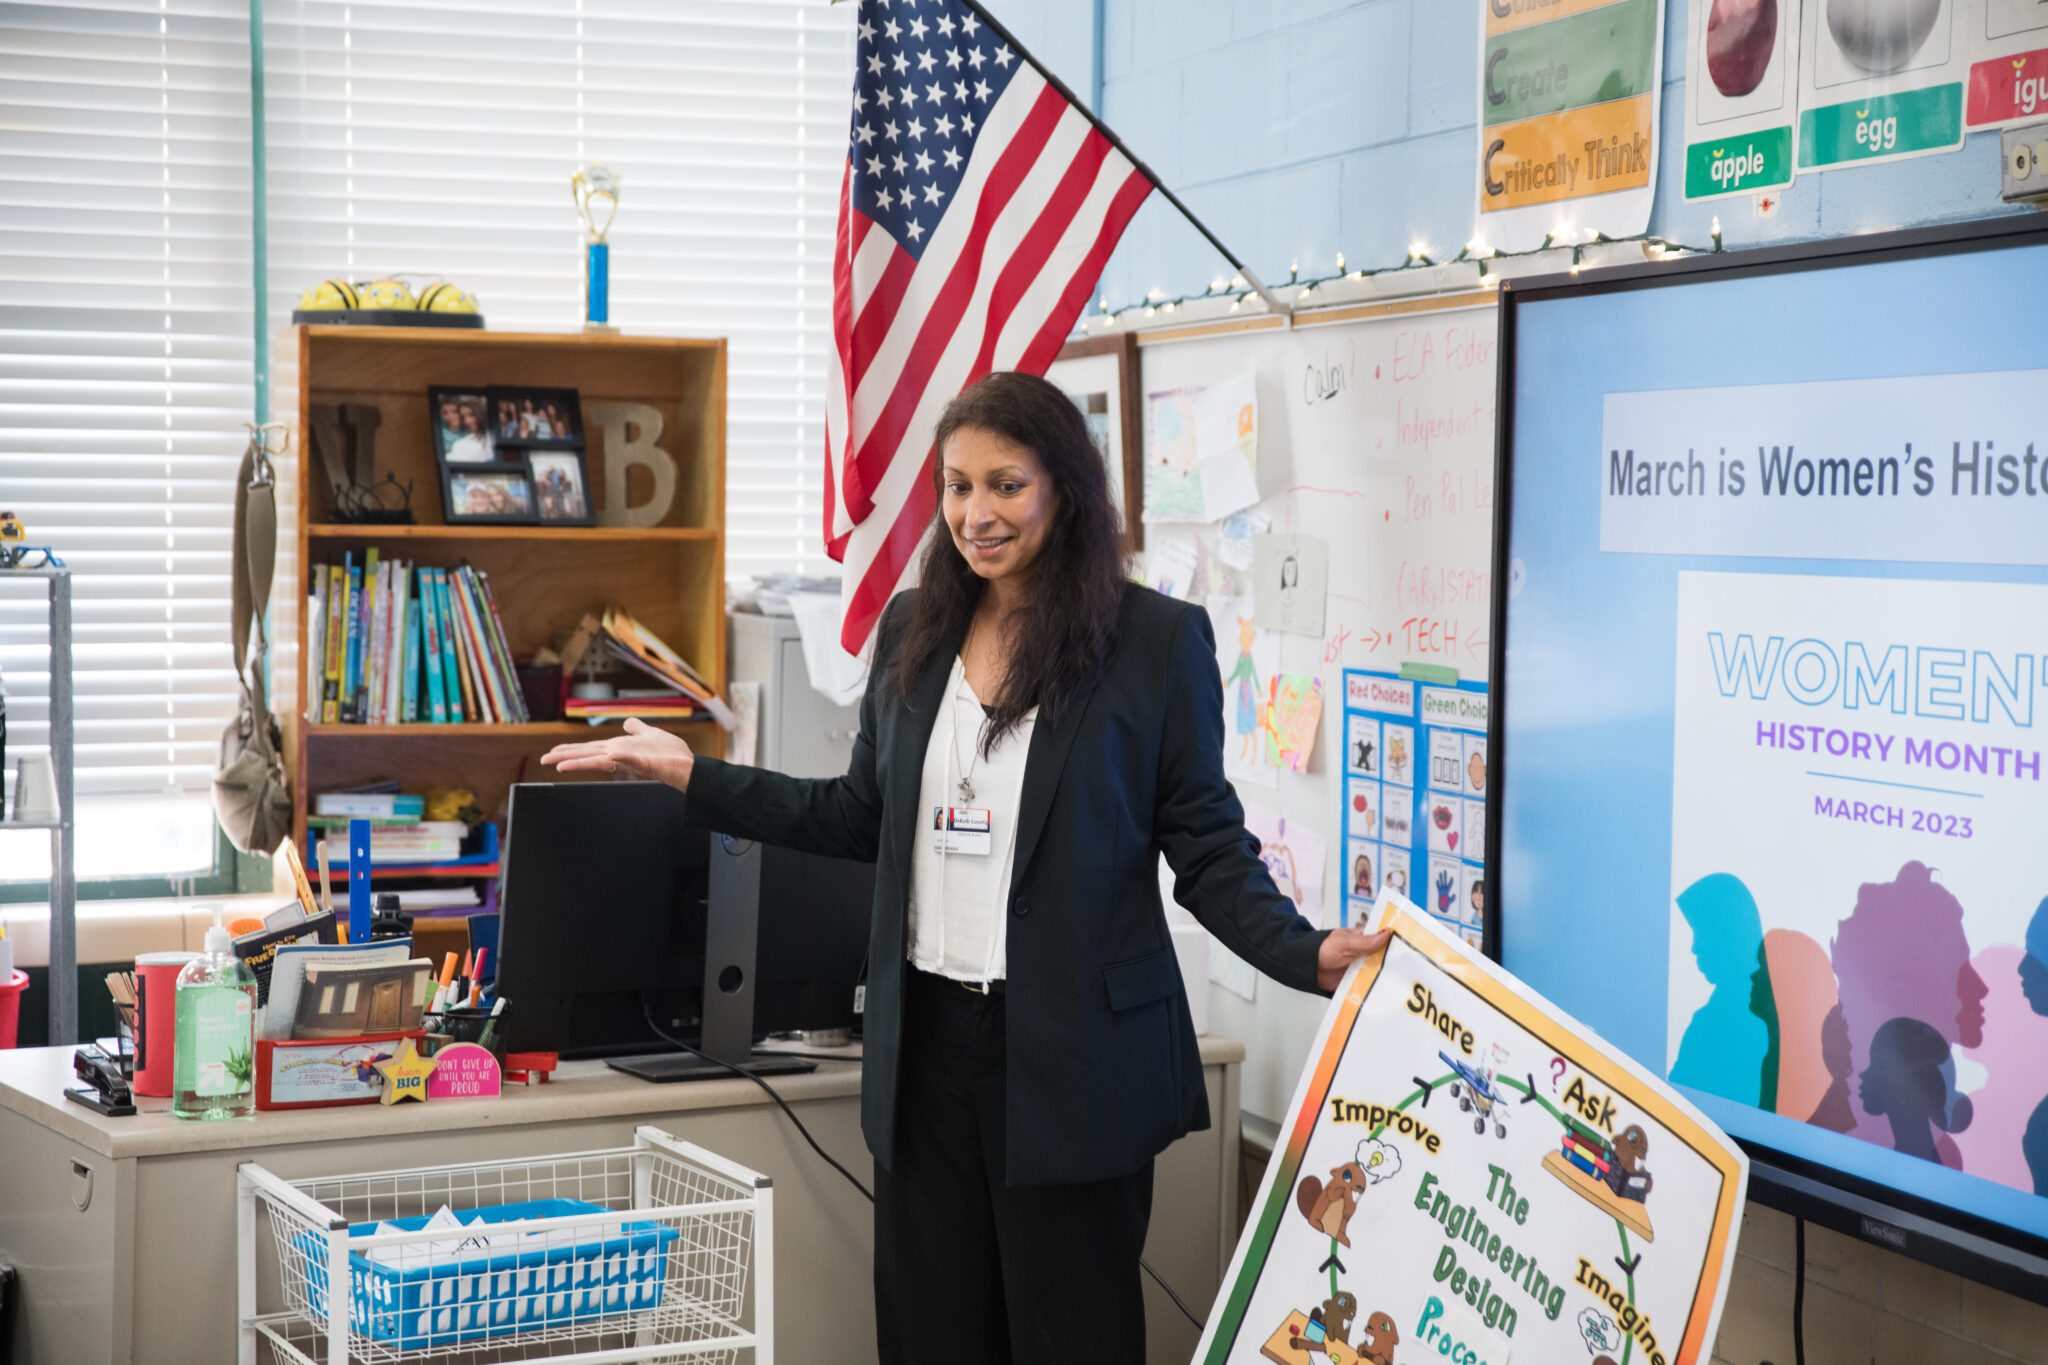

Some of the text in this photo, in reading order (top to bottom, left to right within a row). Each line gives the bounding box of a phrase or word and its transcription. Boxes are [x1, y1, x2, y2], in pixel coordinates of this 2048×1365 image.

[1486, 47, 1569, 106] Create
[1484, 132, 1647, 196] Critically Think
[1393, 331, 1436, 382] ELA
[1397, 399, 1483, 453] Independent
[592, 402, 677, 528] B
[1608, 448, 1705, 497] March
[1718, 447, 1746, 497] is
[1758, 443, 1934, 496] Women's
[1406, 474, 1432, 525] Pen
[1442, 469, 1464, 516] Pal
[1402, 617, 1458, 659] TECH
[1349, 679, 1411, 707] Red Choices
[1424, 693, 1457, 715] Green
[1755, 720, 2042, 782] HISTORY MONTH
[1813, 795, 1974, 840] MARCH 2023
[1406, 982, 1475, 1055] Share
[396, 1076, 421, 1089] BIG
[439, 1070, 490, 1081] UNTIL YOU ARE
[451, 1080, 480, 1096] PROUD
[462, 1058, 481, 1070] GIVE
[484, 1058, 494, 1070] UP
[1330, 1097, 1441, 1154] Improve
[1563, 1076, 1618, 1134] Ask
[1486, 1163, 1531, 1226] The
[1414, 1171, 1567, 1321] Engineering
[1433, 1245, 1518, 1338] Design
[1574, 1256, 1666, 1365] Imagine
[1415, 1296, 1488, 1365] Proce
